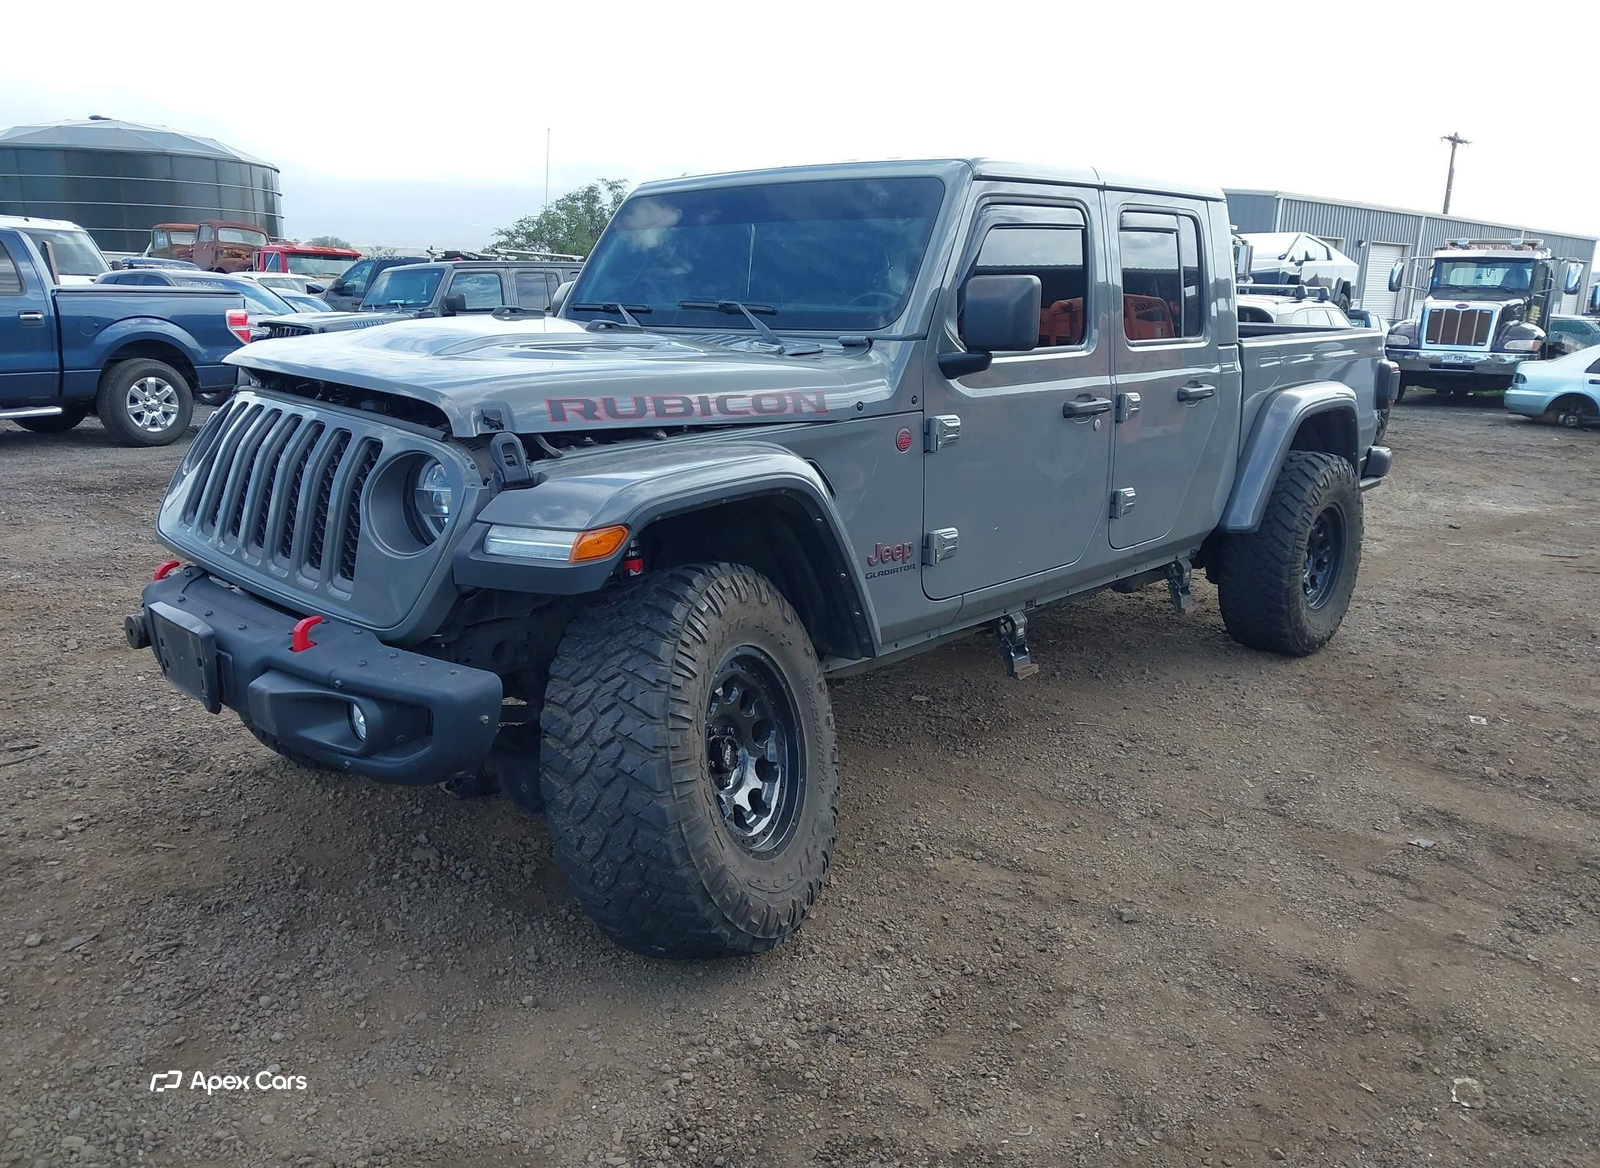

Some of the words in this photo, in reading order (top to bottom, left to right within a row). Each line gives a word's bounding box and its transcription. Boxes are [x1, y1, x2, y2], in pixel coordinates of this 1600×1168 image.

[545, 391, 829, 423] RUBICON
[867, 541, 914, 567] Jeep
[865, 563, 916, 580] GLADIATOR
